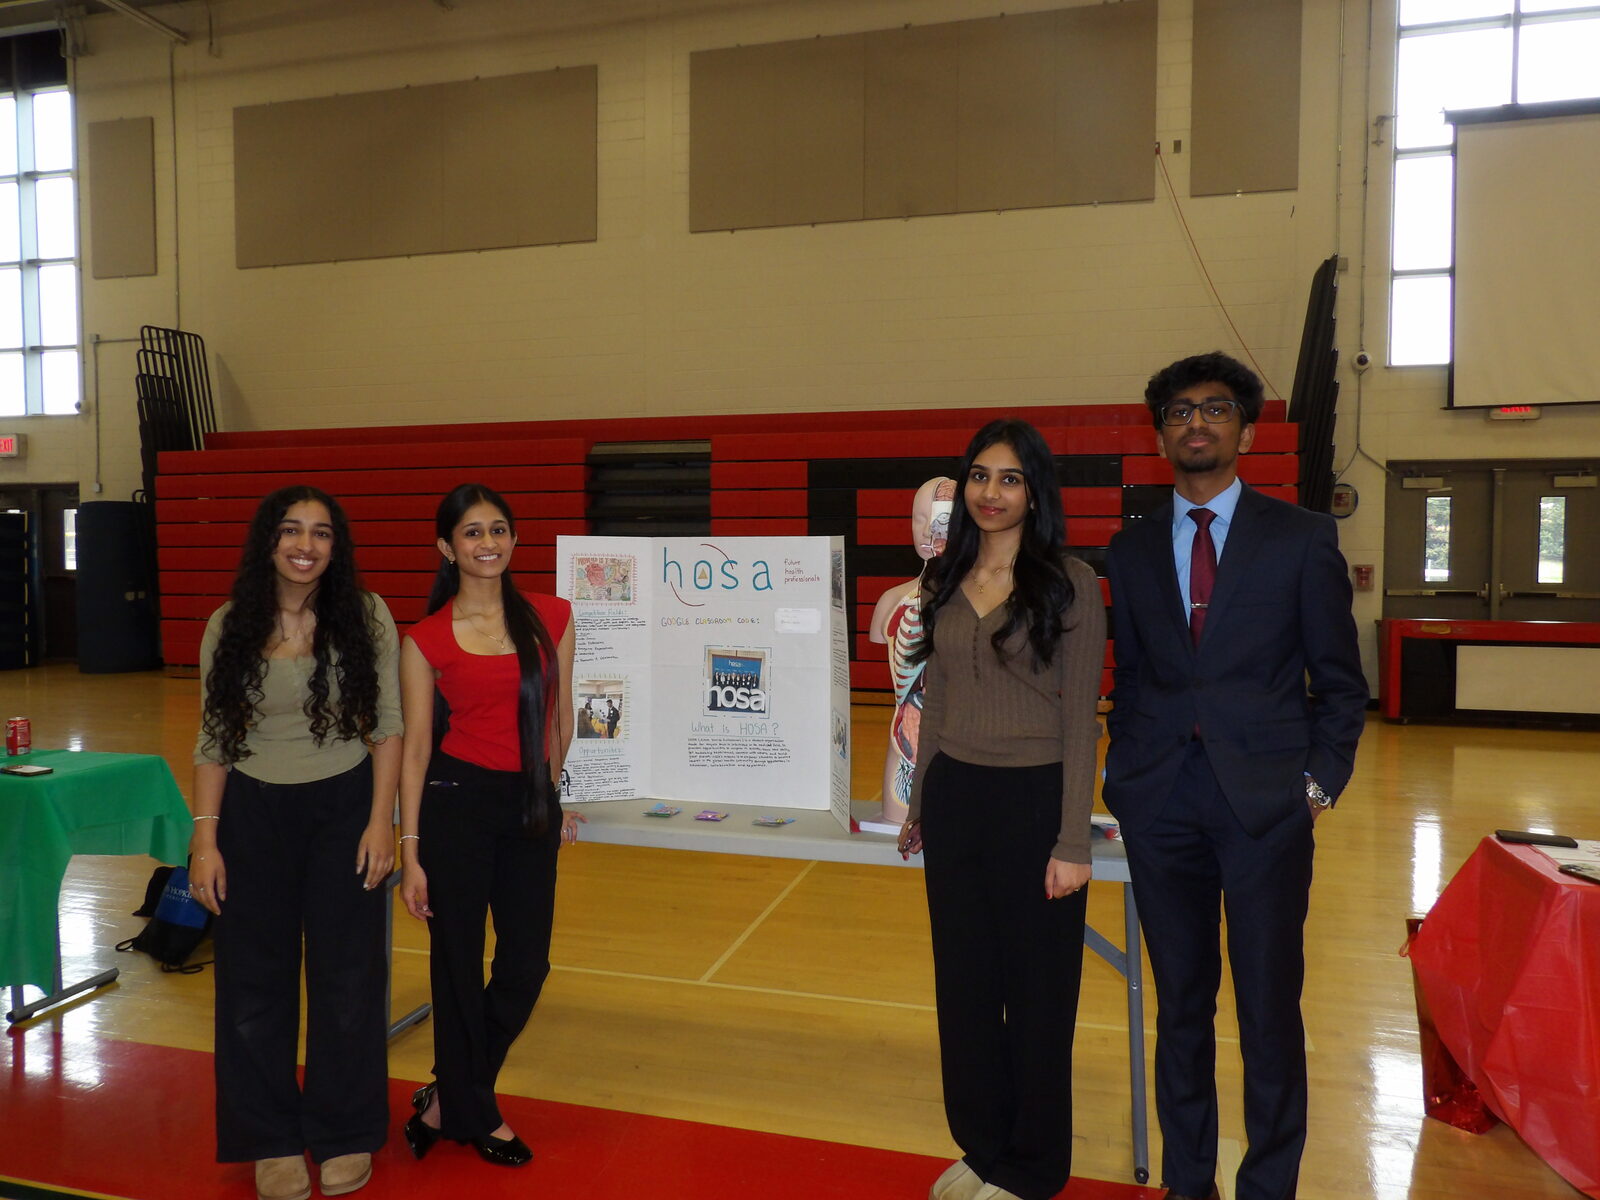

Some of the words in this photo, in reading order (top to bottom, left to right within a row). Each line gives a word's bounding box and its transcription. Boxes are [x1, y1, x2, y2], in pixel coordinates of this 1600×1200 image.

[663, 547, 773, 591] hosa
[784, 568, 804, 576] health
[784, 575, 820, 585] professionals
[660, 616, 690, 627] GOOGLE
[691, 721, 713, 733] What
[722, 723, 730, 733] is
[739, 722, 767, 736] HOSA
